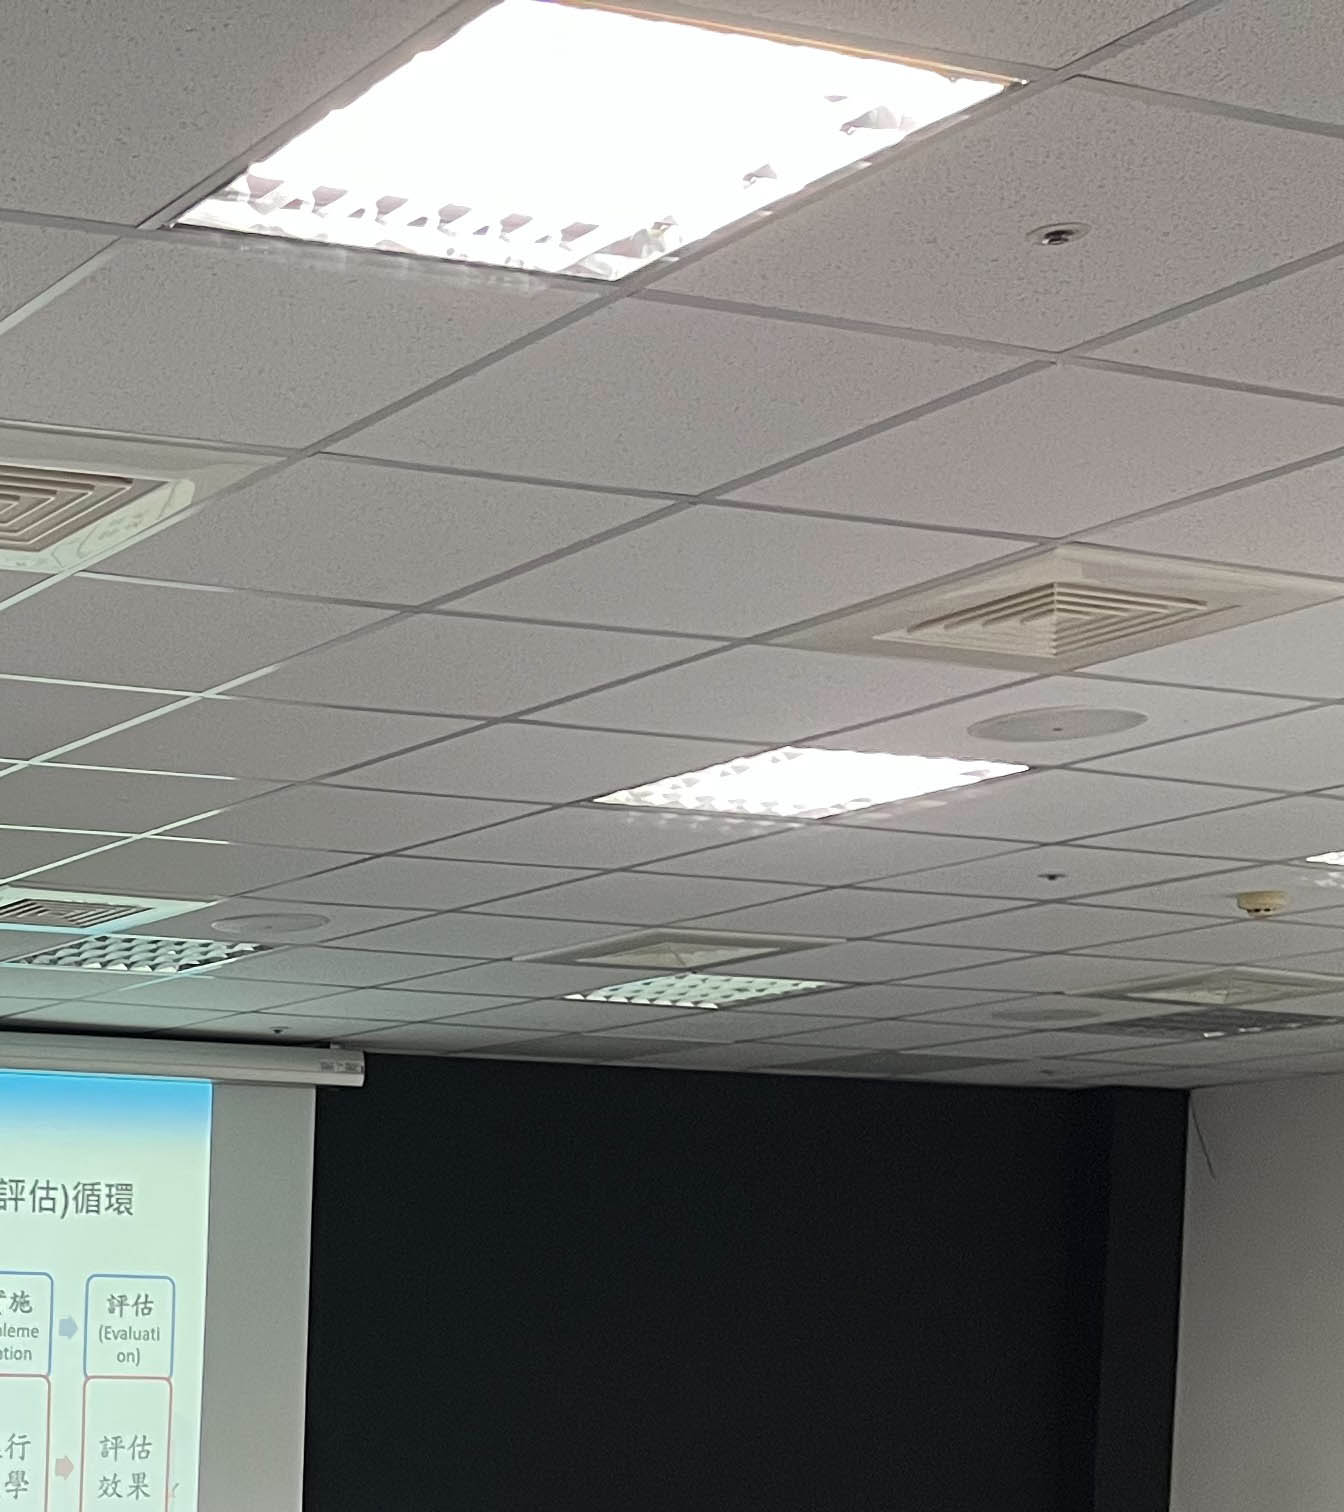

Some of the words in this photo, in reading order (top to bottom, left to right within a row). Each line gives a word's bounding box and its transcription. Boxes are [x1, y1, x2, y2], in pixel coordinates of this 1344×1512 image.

[106, 1292, 155, 1318] 評估
[98, 1325, 161, 1345] (Evaluati
[116, 1349, 141, 1367] on)
[98, 1434, 153, 1463] 評估
[97, 1471, 152, 1500] 效果
